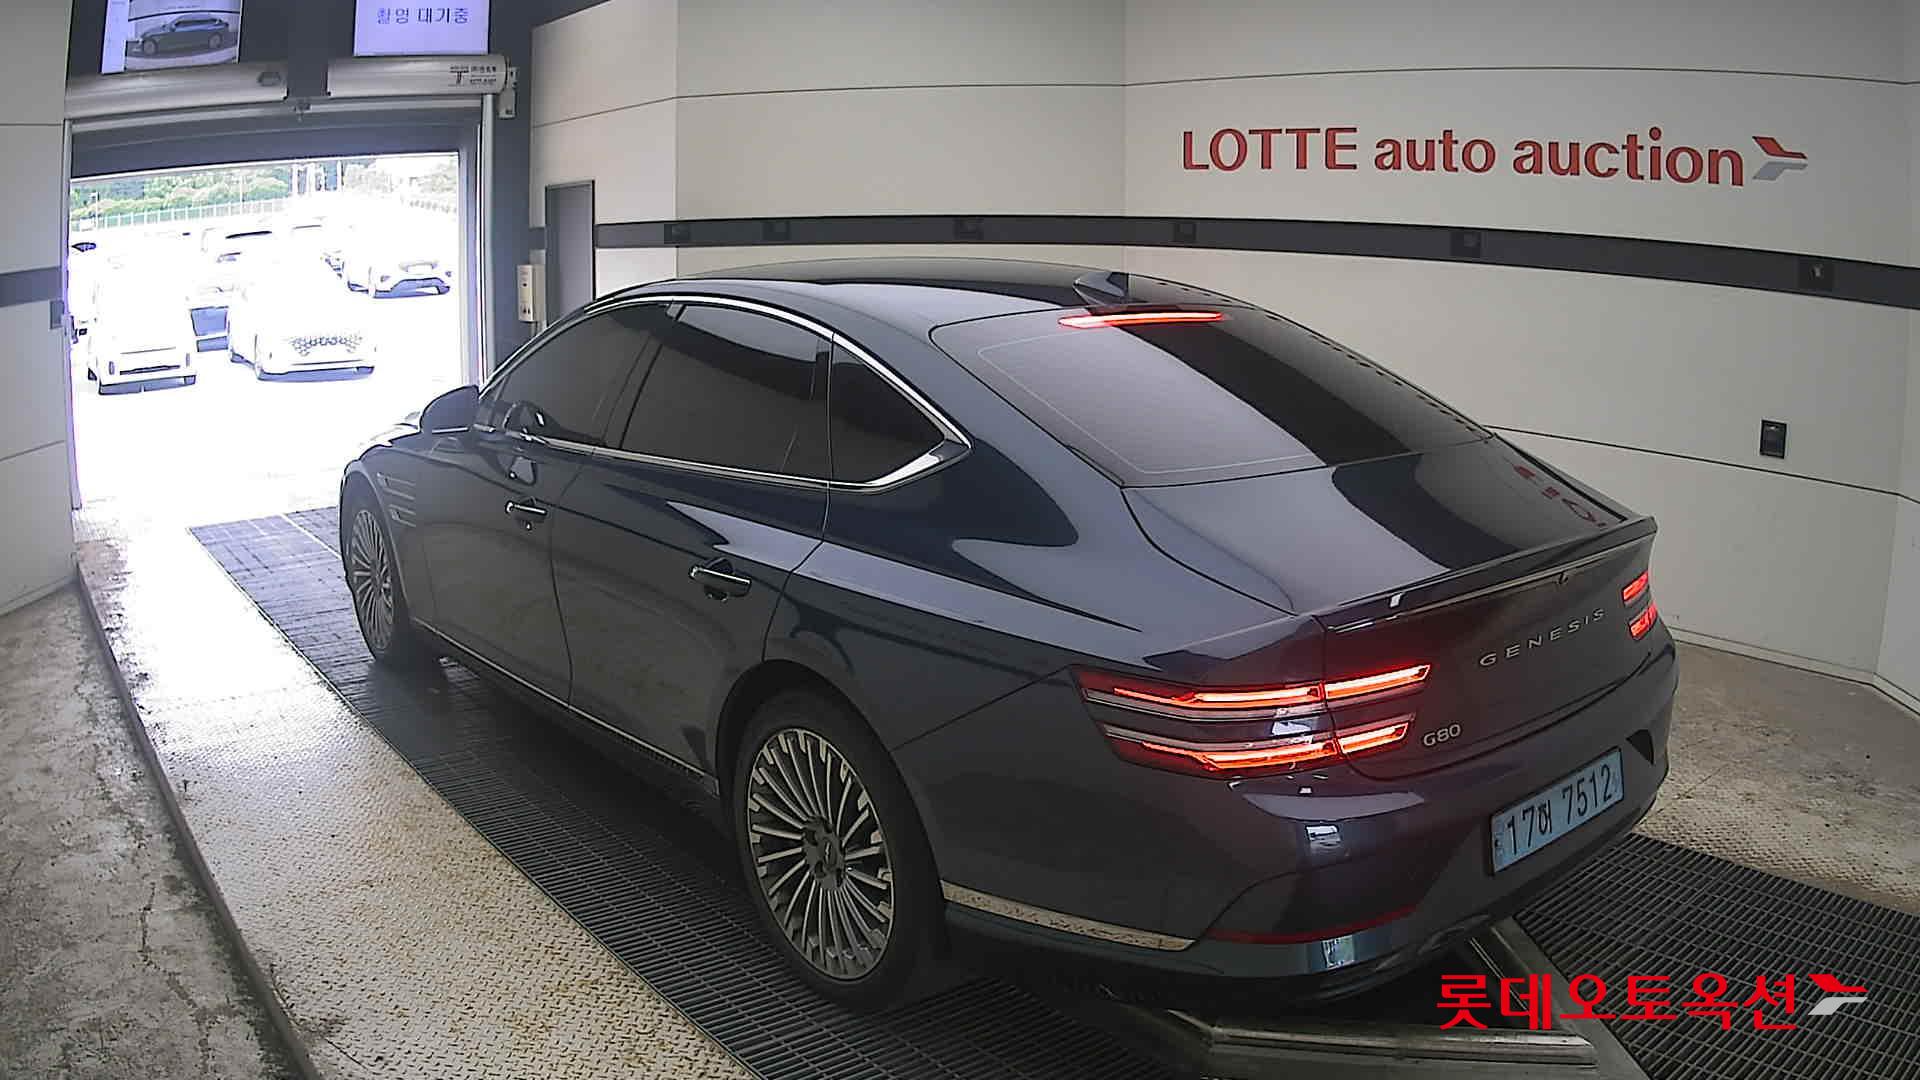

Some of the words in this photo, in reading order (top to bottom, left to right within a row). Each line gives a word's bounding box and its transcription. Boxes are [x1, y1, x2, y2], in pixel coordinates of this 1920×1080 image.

[417, 7, 469, 25] 대기중
[1183, 127, 1358, 171] LOTTE
[1374, 129, 1496, 173] auto
[1512, 126, 1744, 187] auction
[1479, 608, 1605, 667] GENESIS
[1423, 723, 1462, 747] G80
[1562, 764, 1612, 825] 7512
